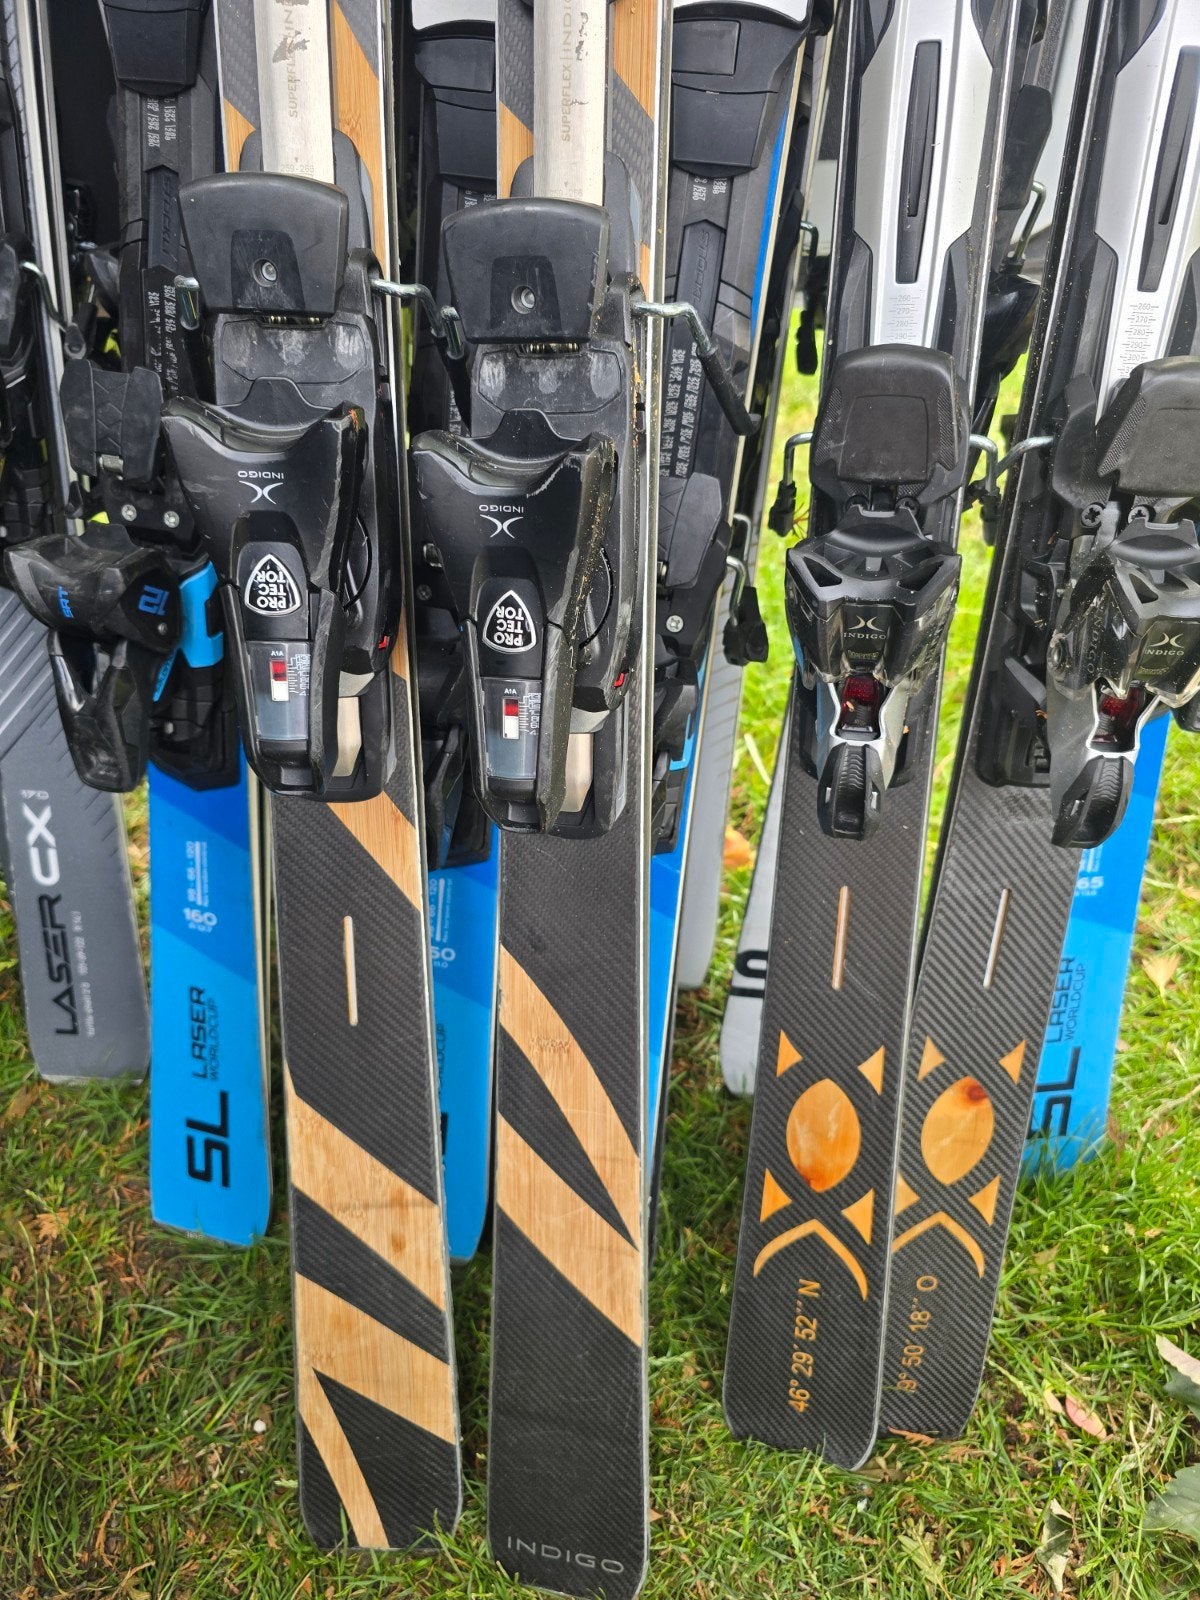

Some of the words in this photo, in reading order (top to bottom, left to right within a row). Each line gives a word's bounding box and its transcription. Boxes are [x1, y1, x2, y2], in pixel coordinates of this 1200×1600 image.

[562, 0, 573, 52] INDI
[561, 64, 572, 142] SUPERFLEX
[237, 470, 284, 480] INDIGO
[478, 504, 524, 514] INDIGO
[256, 570, 287, 584] TOR
[257, 583, 288, 597] TEC
[257, 596, 287, 610] PRO
[494, 605, 524, 620] TOR
[495, 619, 524, 633] TEC
[843, 632, 887, 640] INDIGO
[493, 632, 524, 647] PRO
[22, 805, 61, 887] CX
[182, 906, 218, 928] 160
[38, 893, 79, 1036] LASER
[1045, 956, 1076, 1044] LASER
[1064, 963, 1087, 1041] WORLDCUP
[188, 986, 206, 1080] LASER
[206, 998, 218, 1081] WORLDCUP
[1026, 1046, 1082, 1139] SL
[186, 1090, 231, 1188] SL
[797, 1278, 821, 1299] N
[915, 1275, 939, 1292] O
[507, 1535, 625, 1575] INDIGO
